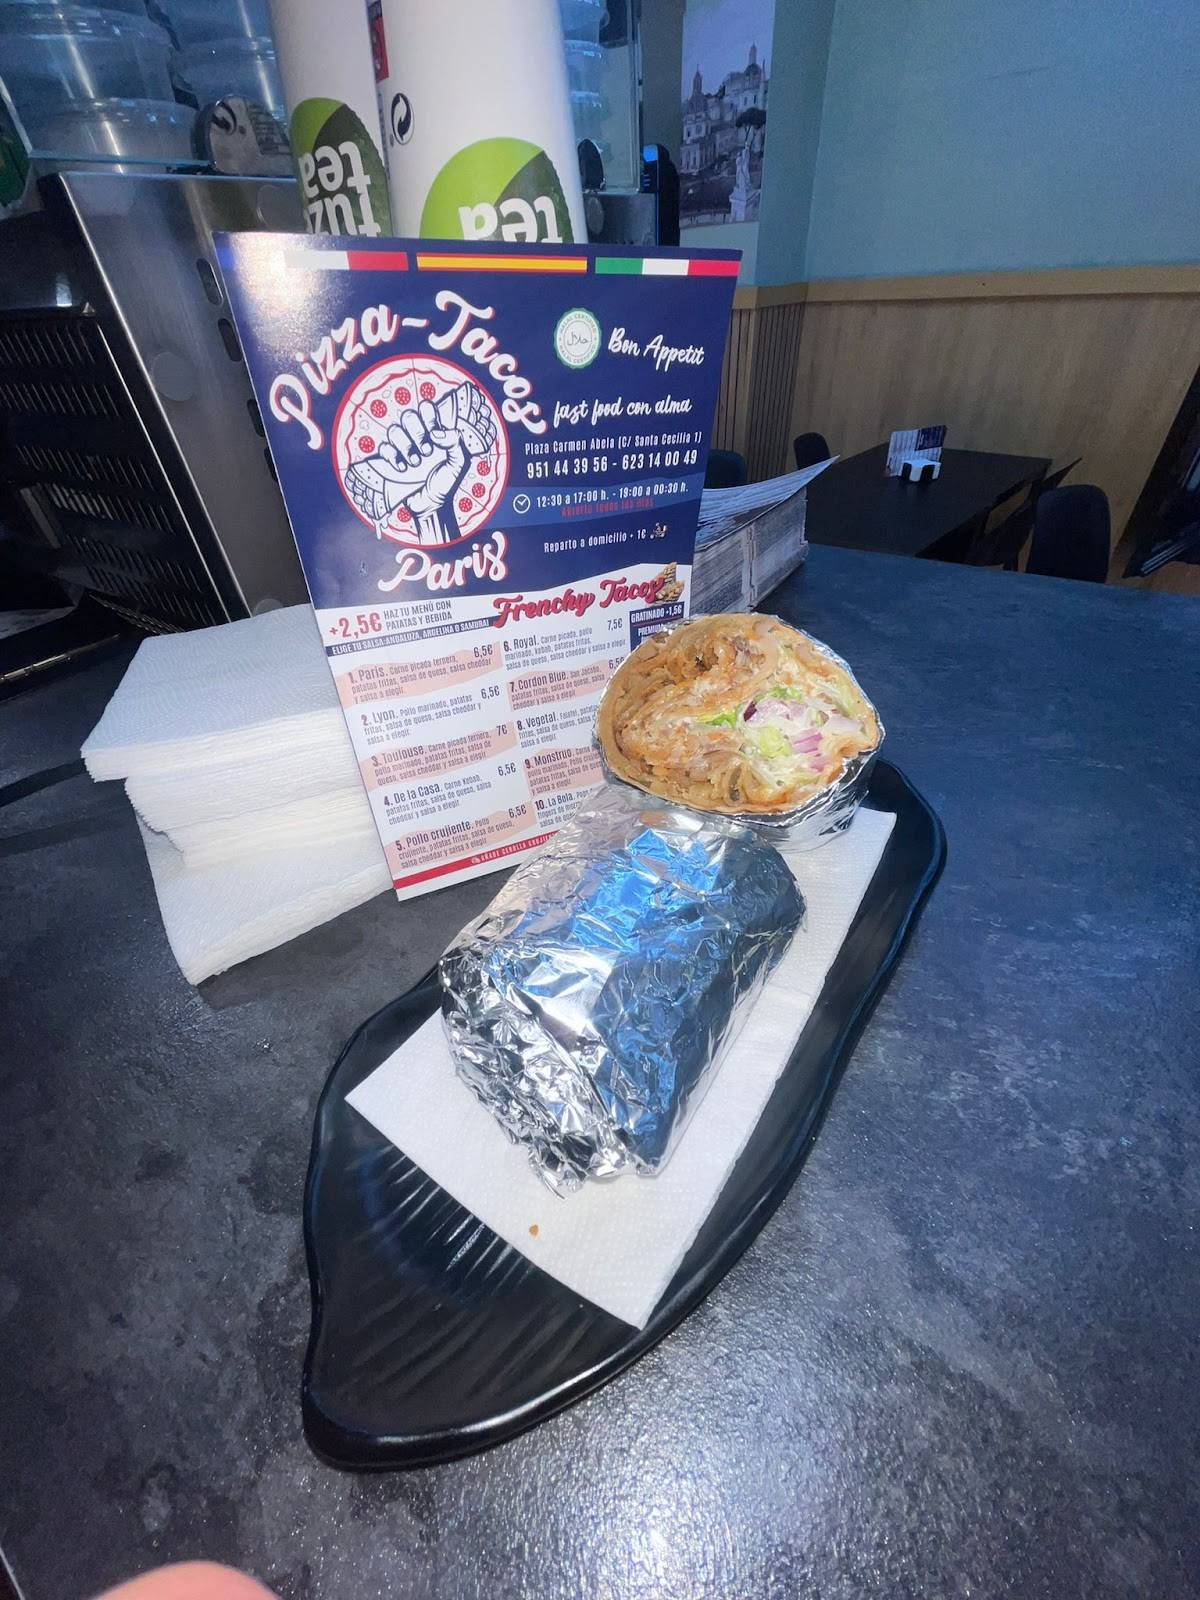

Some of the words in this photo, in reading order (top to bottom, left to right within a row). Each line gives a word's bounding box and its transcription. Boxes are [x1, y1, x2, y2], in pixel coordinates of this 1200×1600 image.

[298, 141, 371, 197] tea
[304, 194, 381, 237] fuz
[458, 195, 563, 243] tea
[608, 328, 640, 356] Bon
[643, 335, 704, 371] Appetit
[269, 290, 548, 450] Pizza-Tacos
[554, 401, 588, 428] fast
[592, 397, 624, 425] food
[627, 402, 651, 415] con
[655, 394, 692, 414] alma
[525, 443, 550, 455] Plaza
[553, 440, 587, 452] Carmen
[590, 437, 614, 450] Abela
[635, 435, 658, 447] Santa
[662, 432, 690, 445] Cecilia
[527, 462, 549, 478] 951
[554, 460, 568, 475] 44
[574, 458, 588, 474] 39
[593, 456, 608, 472] 56
[622, 454, 644, 470] 623
[649, 452, 660, 467] 14
[665, 451, 679, 466] 00
[684, 450, 697, 465] 49
[537, 495, 562, 508] 12:30
[566, 495, 570, 504] a
[574, 490, 598, 503] 17:00
[601, 489, 609, 500] h.
[619, 486, 642, 498] 19:00
[646, 486, 650, 495] a
[654, 483, 678, 495] 00:30
[544, 542, 577, 553] Reparto
[589, 531, 627, 546] domicilio
[378, 531, 508, 591] Paris
[384, 609, 399, 619] HAZ
[400, 607, 409, 616] TU
[412, 601, 434, 615] MENÚ
[436, 600, 451, 610] CON
[493, 588, 595, 628] Frenchy
[599, 576, 667, 608] Tacos
[386, 617, 417, 631] PATATAS
[418, 616, 423, 624] Y
[425, 612, 452, 623] BEBIDA
[607, 617, 622, 631] 7,5€
[631, 608, 664, 623] GRATINADO
[329, 612, 382, 639] +2,5€
[332, 644, 352, 654] ELIGE
[352, 643, 361, 651] TU
[422, 625, 454, 638] ARGELINA
[460, 619, 489, 631] SAMURAI
[504, 641, 511, 652] 6.
[513, 635, 539, 650] Royal.
[474, 644, 493, 658] 6,5€
[481, 685, 500, 700] 6,5€
[509, 681, 517, 693] 7.
[518, 674, 547, 691] Cordon
[496, 724, 508, 736] 7€
[517, 720, 525, 731] 8.
[525, 711, 559, 728] Vegetal.
[498, 762, 516, 777] 6,5€
[525, 759, 534, 769] 9.
[393, 793, 406, 804] De
[408, 790, 418, 800] la
[535, 800, 548, 811] 10.
[548, 798, 556, 807] La
[508, 804, 526, 819] 6,5€
[406, 833, 428, 847] Pollo
